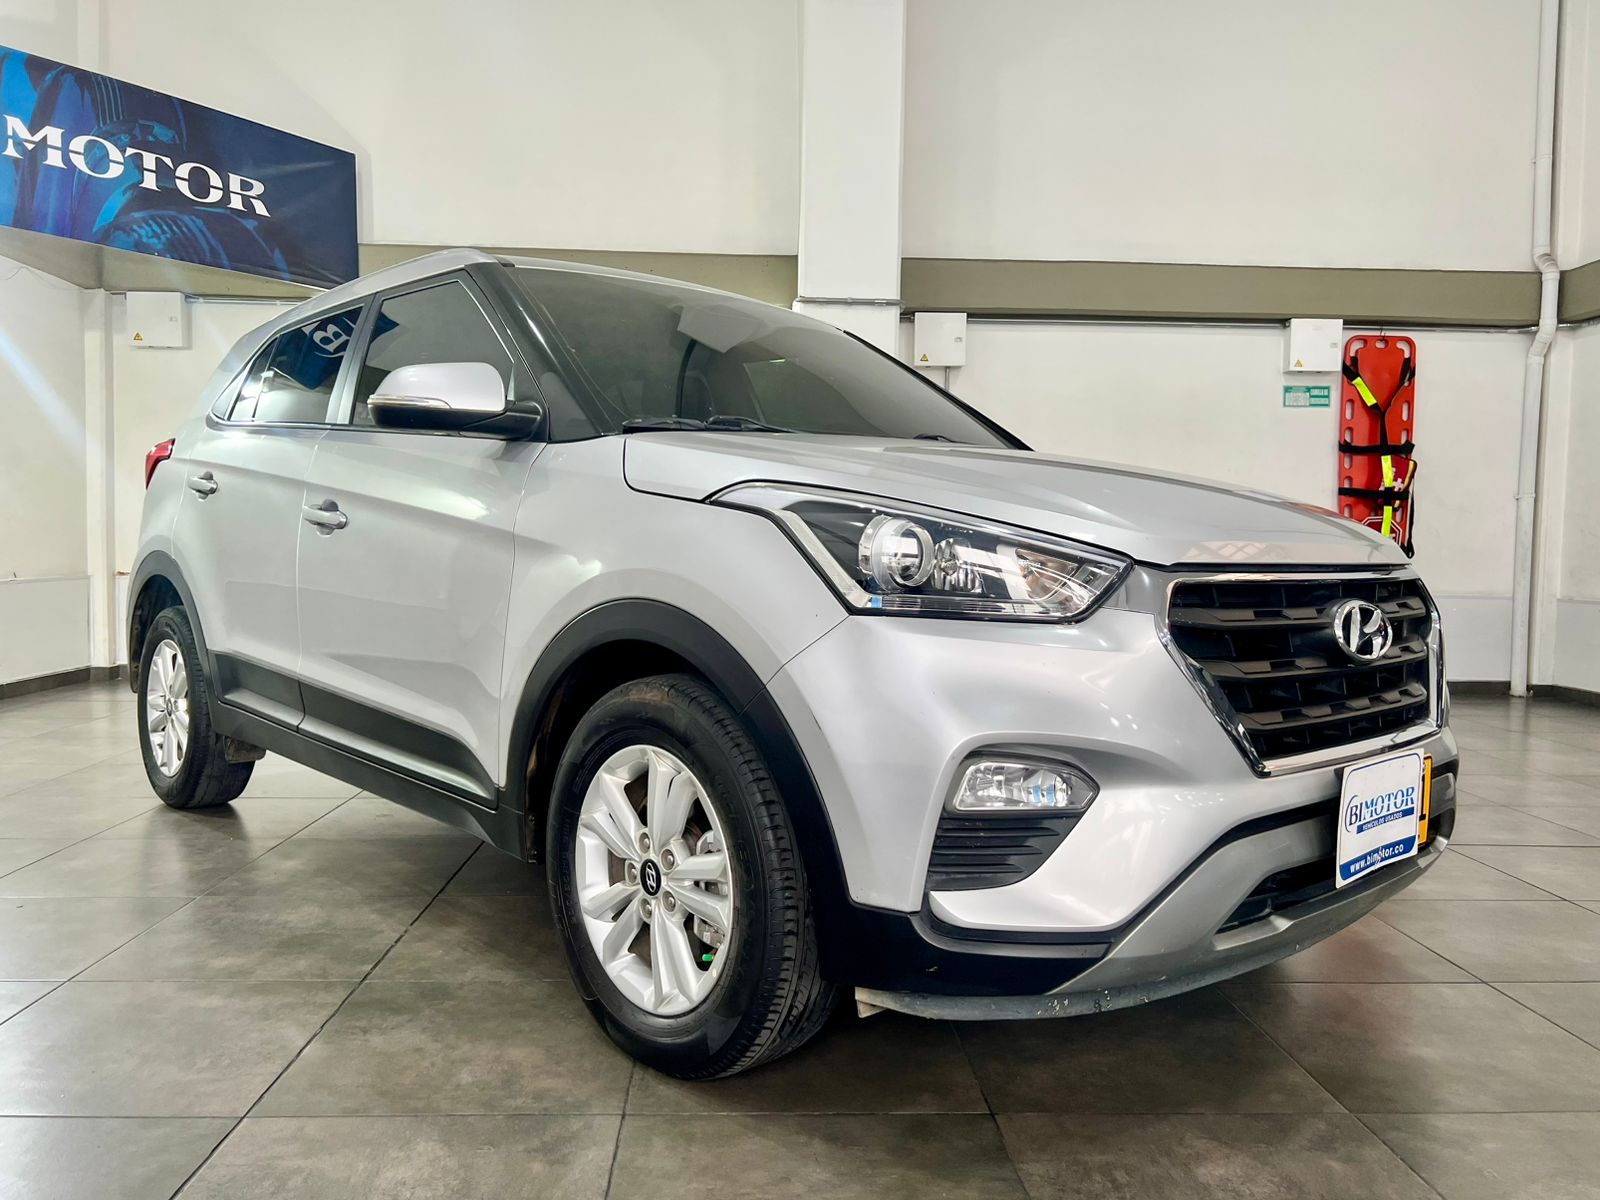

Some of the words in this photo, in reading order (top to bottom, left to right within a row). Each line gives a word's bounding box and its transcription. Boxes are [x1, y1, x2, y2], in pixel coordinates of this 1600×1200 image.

[2, 114, 271, 217] MOTOR
[1348, 786, 1415, 826] BIMOTOR
[1350, 844, 1404, 873] www.bimotor.co
